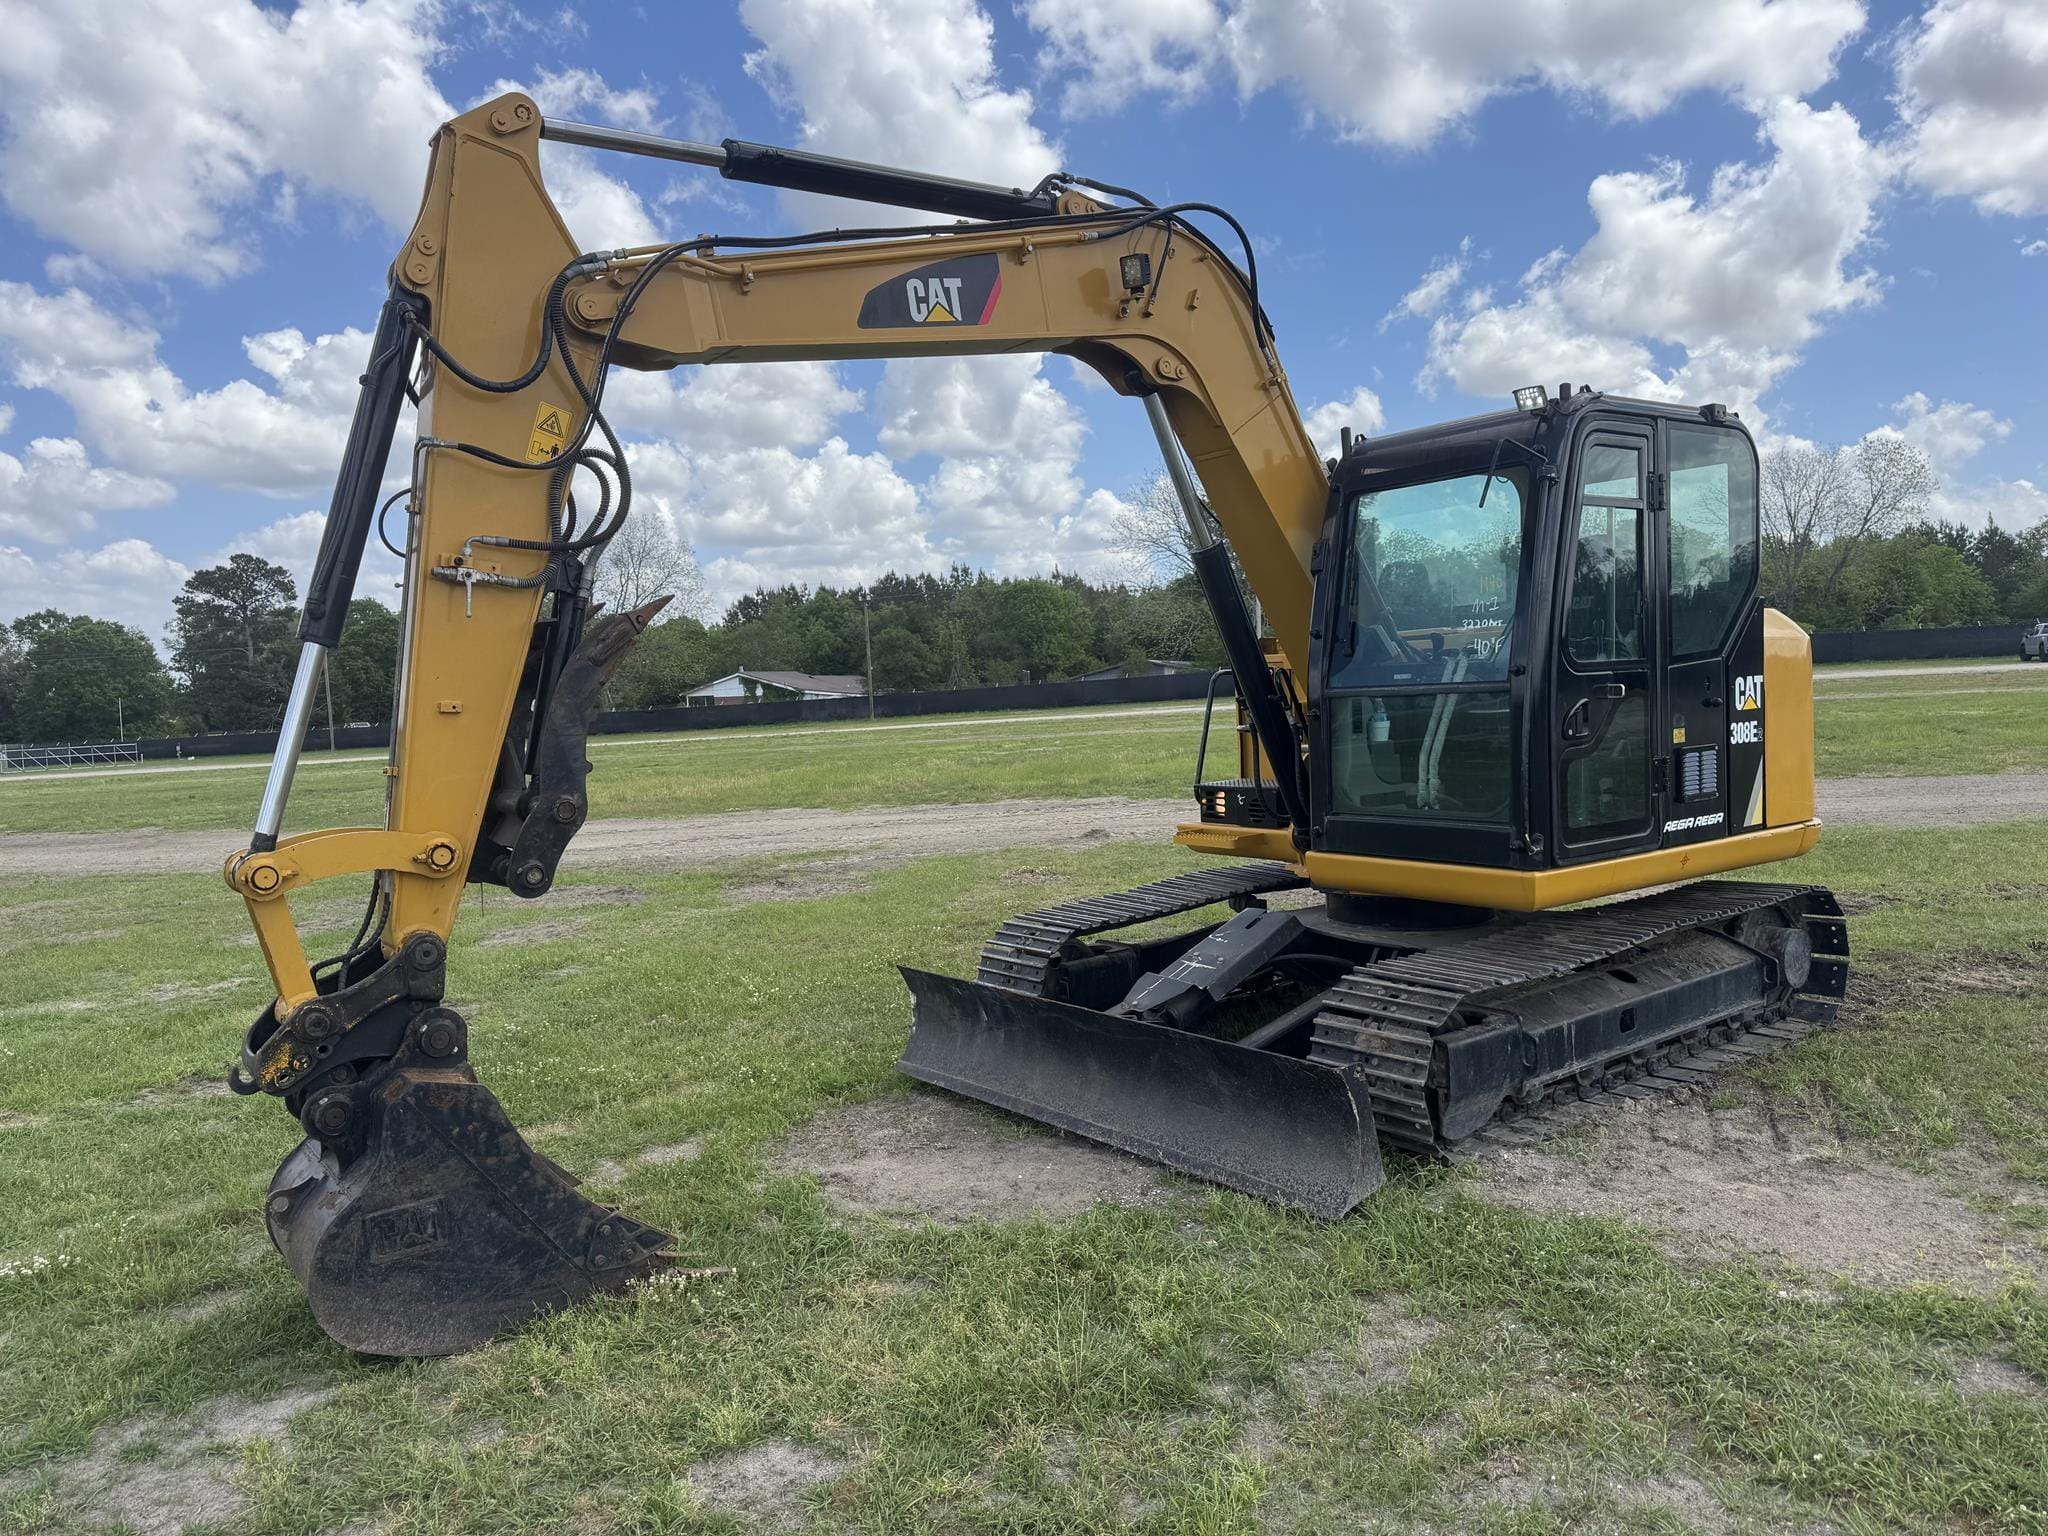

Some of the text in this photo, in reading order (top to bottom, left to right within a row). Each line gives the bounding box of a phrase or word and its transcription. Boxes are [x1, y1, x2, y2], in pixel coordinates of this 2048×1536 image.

[906, 278, 962, 322] CAT
[1735, 675, 1763, 710] CAT
[1663, 812, 1724, 833] REGA REGA
